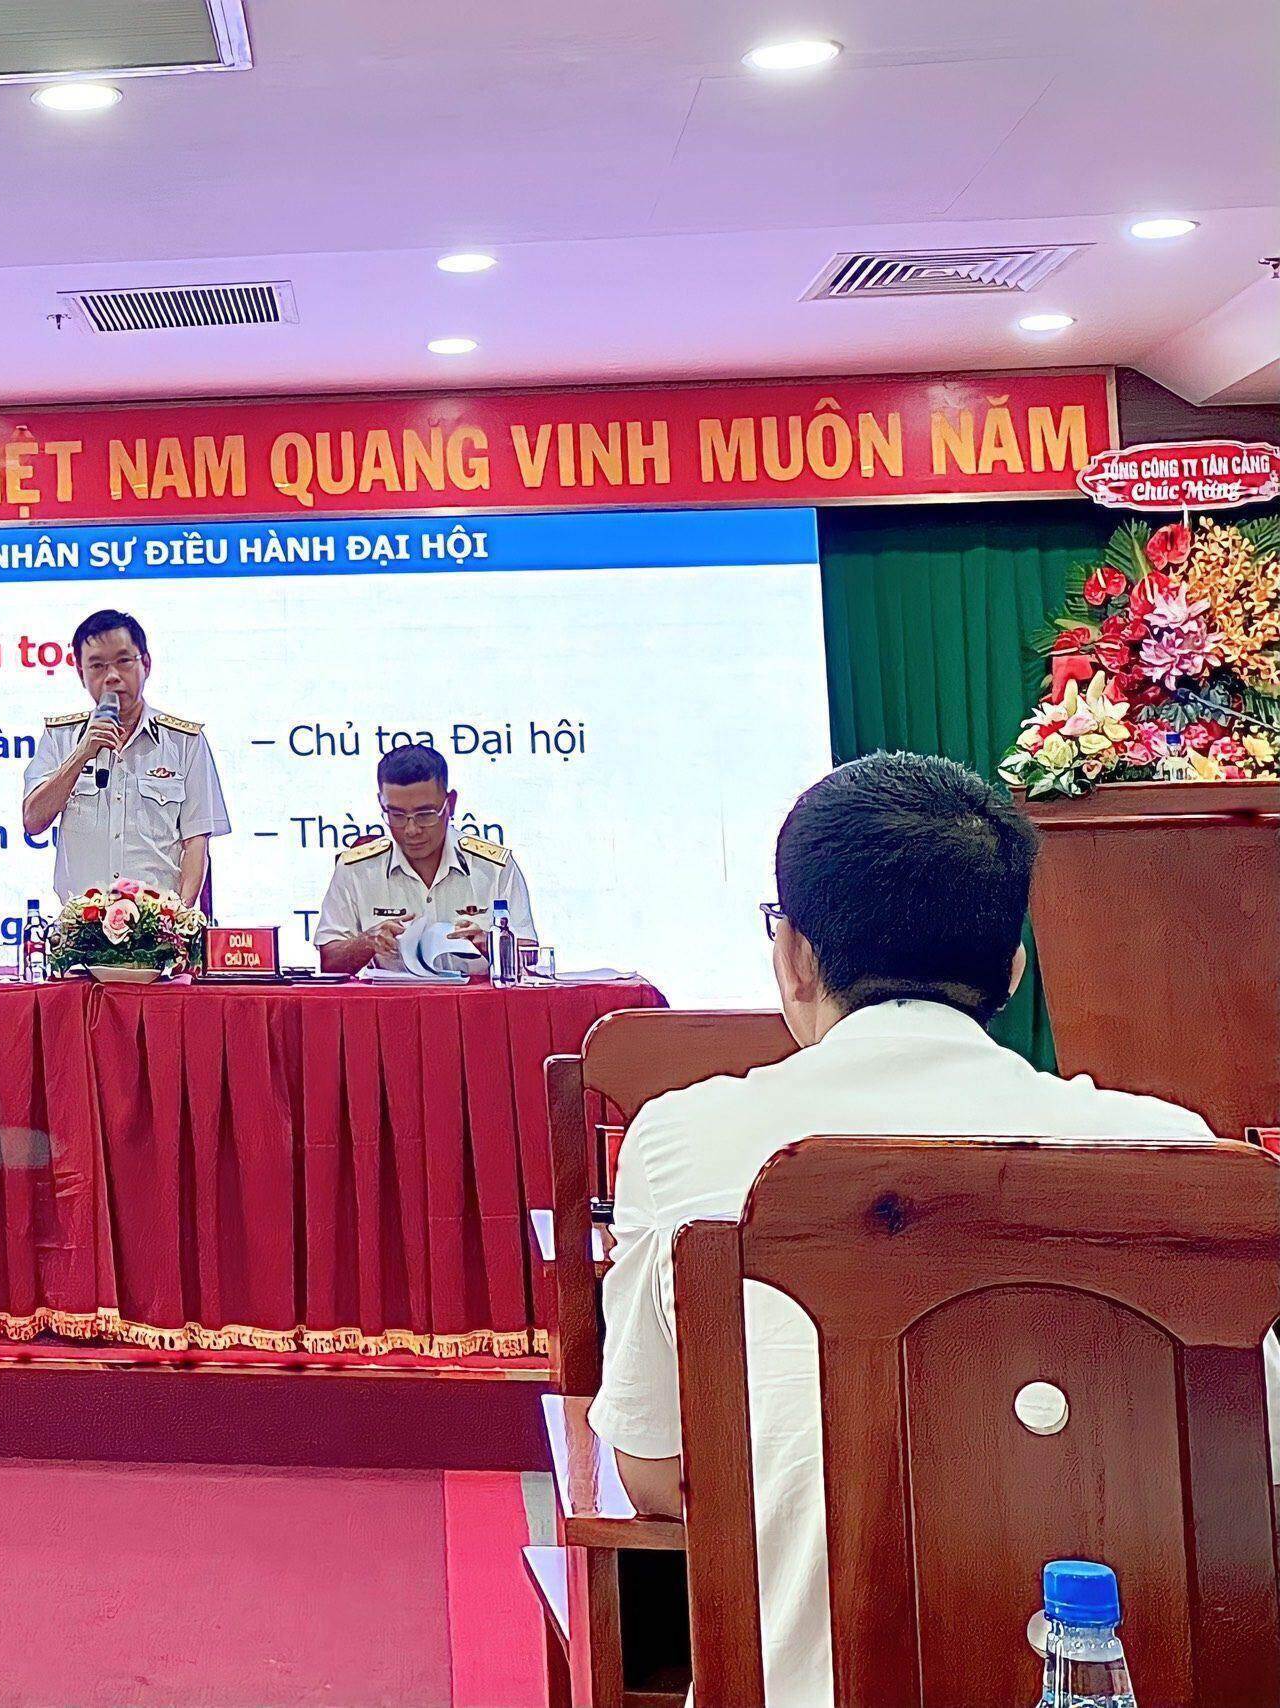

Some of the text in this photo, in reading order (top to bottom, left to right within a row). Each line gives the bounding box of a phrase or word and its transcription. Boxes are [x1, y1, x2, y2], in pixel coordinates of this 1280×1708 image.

[109, 434, 247, 499] NAM
[270, 424, 490, 507] QUANG
[510, 420, 671, 488] VINH
[698, 397, 903, 482] MUÔN
[931, 394, 1090, 475] NĂM
[1181, 458, 1199, 477] TY
[1131, 480, 1179, 501] Chúc
[89, 536, 137, 572] SỰ
[144, 531, 228, 565] ĐIỀU
[239, 529, 335, 563] HÀNH
[345, 534, 410, 566] ĐẠI
[421, 524, 489, 564] HỘI
[289, 721, 360, 756] Chủ
[451, 723, 512, 762] Đại
[530, 719, 585, 761] hội
[290, 813, 385, 848] Thàn
